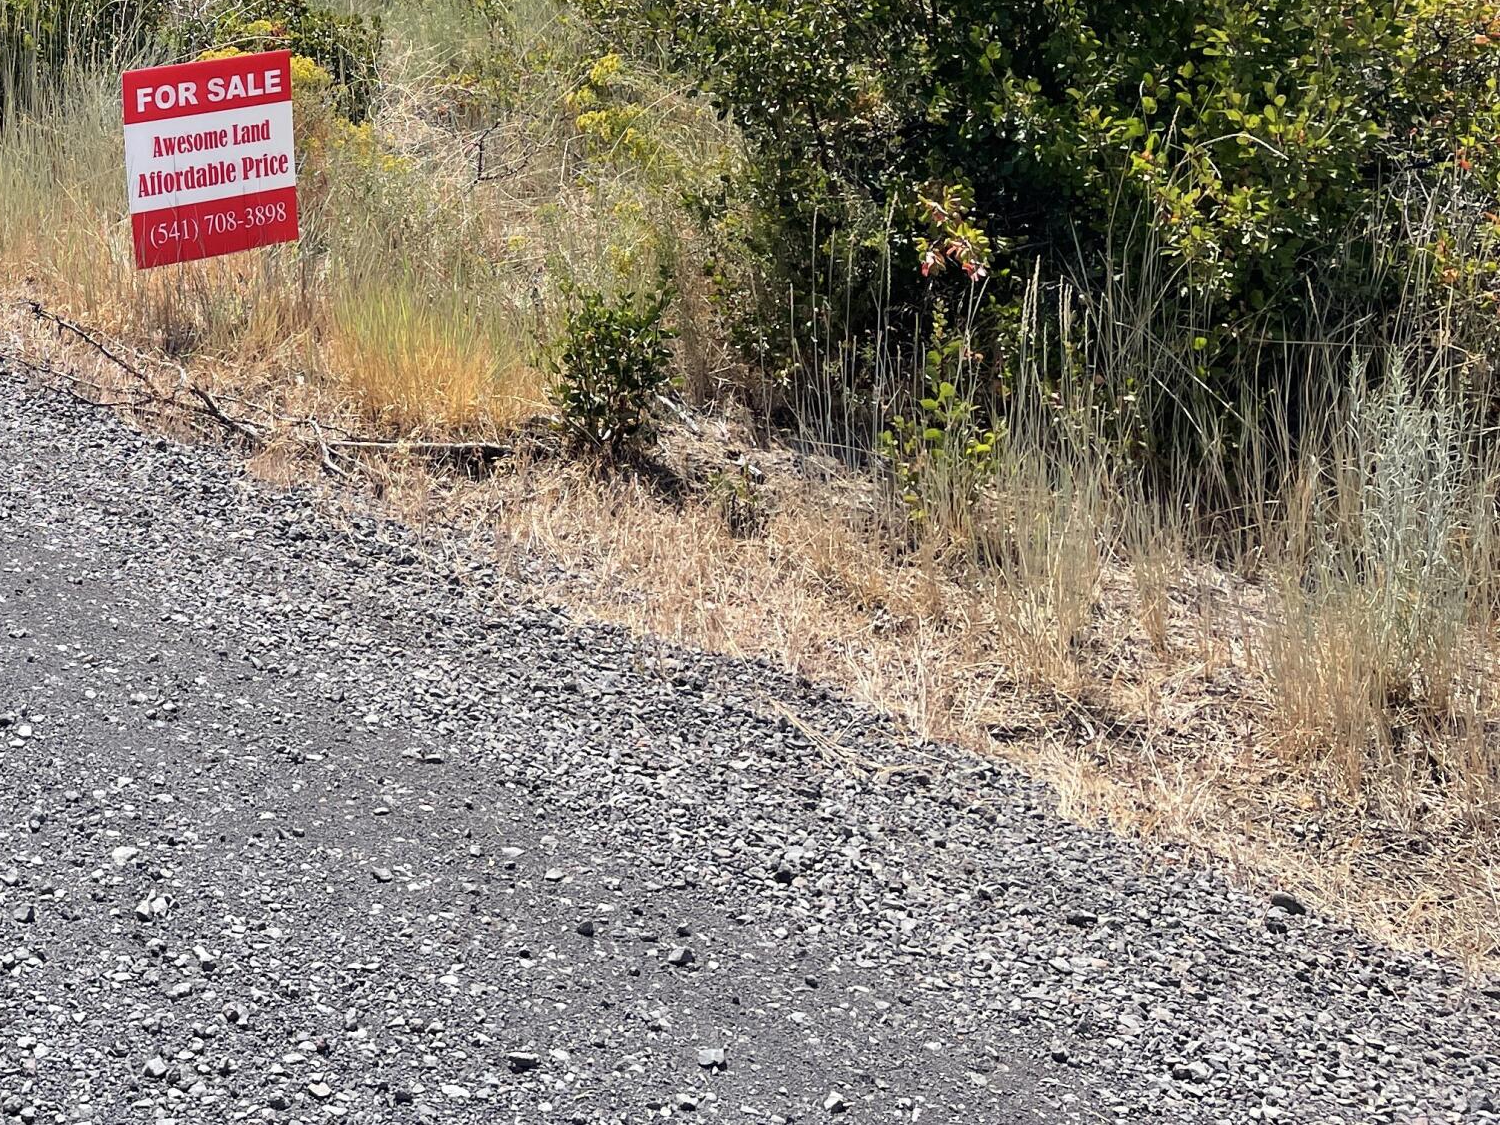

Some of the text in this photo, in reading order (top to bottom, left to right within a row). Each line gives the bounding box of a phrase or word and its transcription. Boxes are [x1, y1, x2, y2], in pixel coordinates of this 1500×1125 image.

[136, 69, 282, 113] FOR SALE
[152, 119, 271, 158] Awesome Land
[138, 153, 289, 198] Affordable Price
[150, 201, 287, 249] (541) 708-3898
